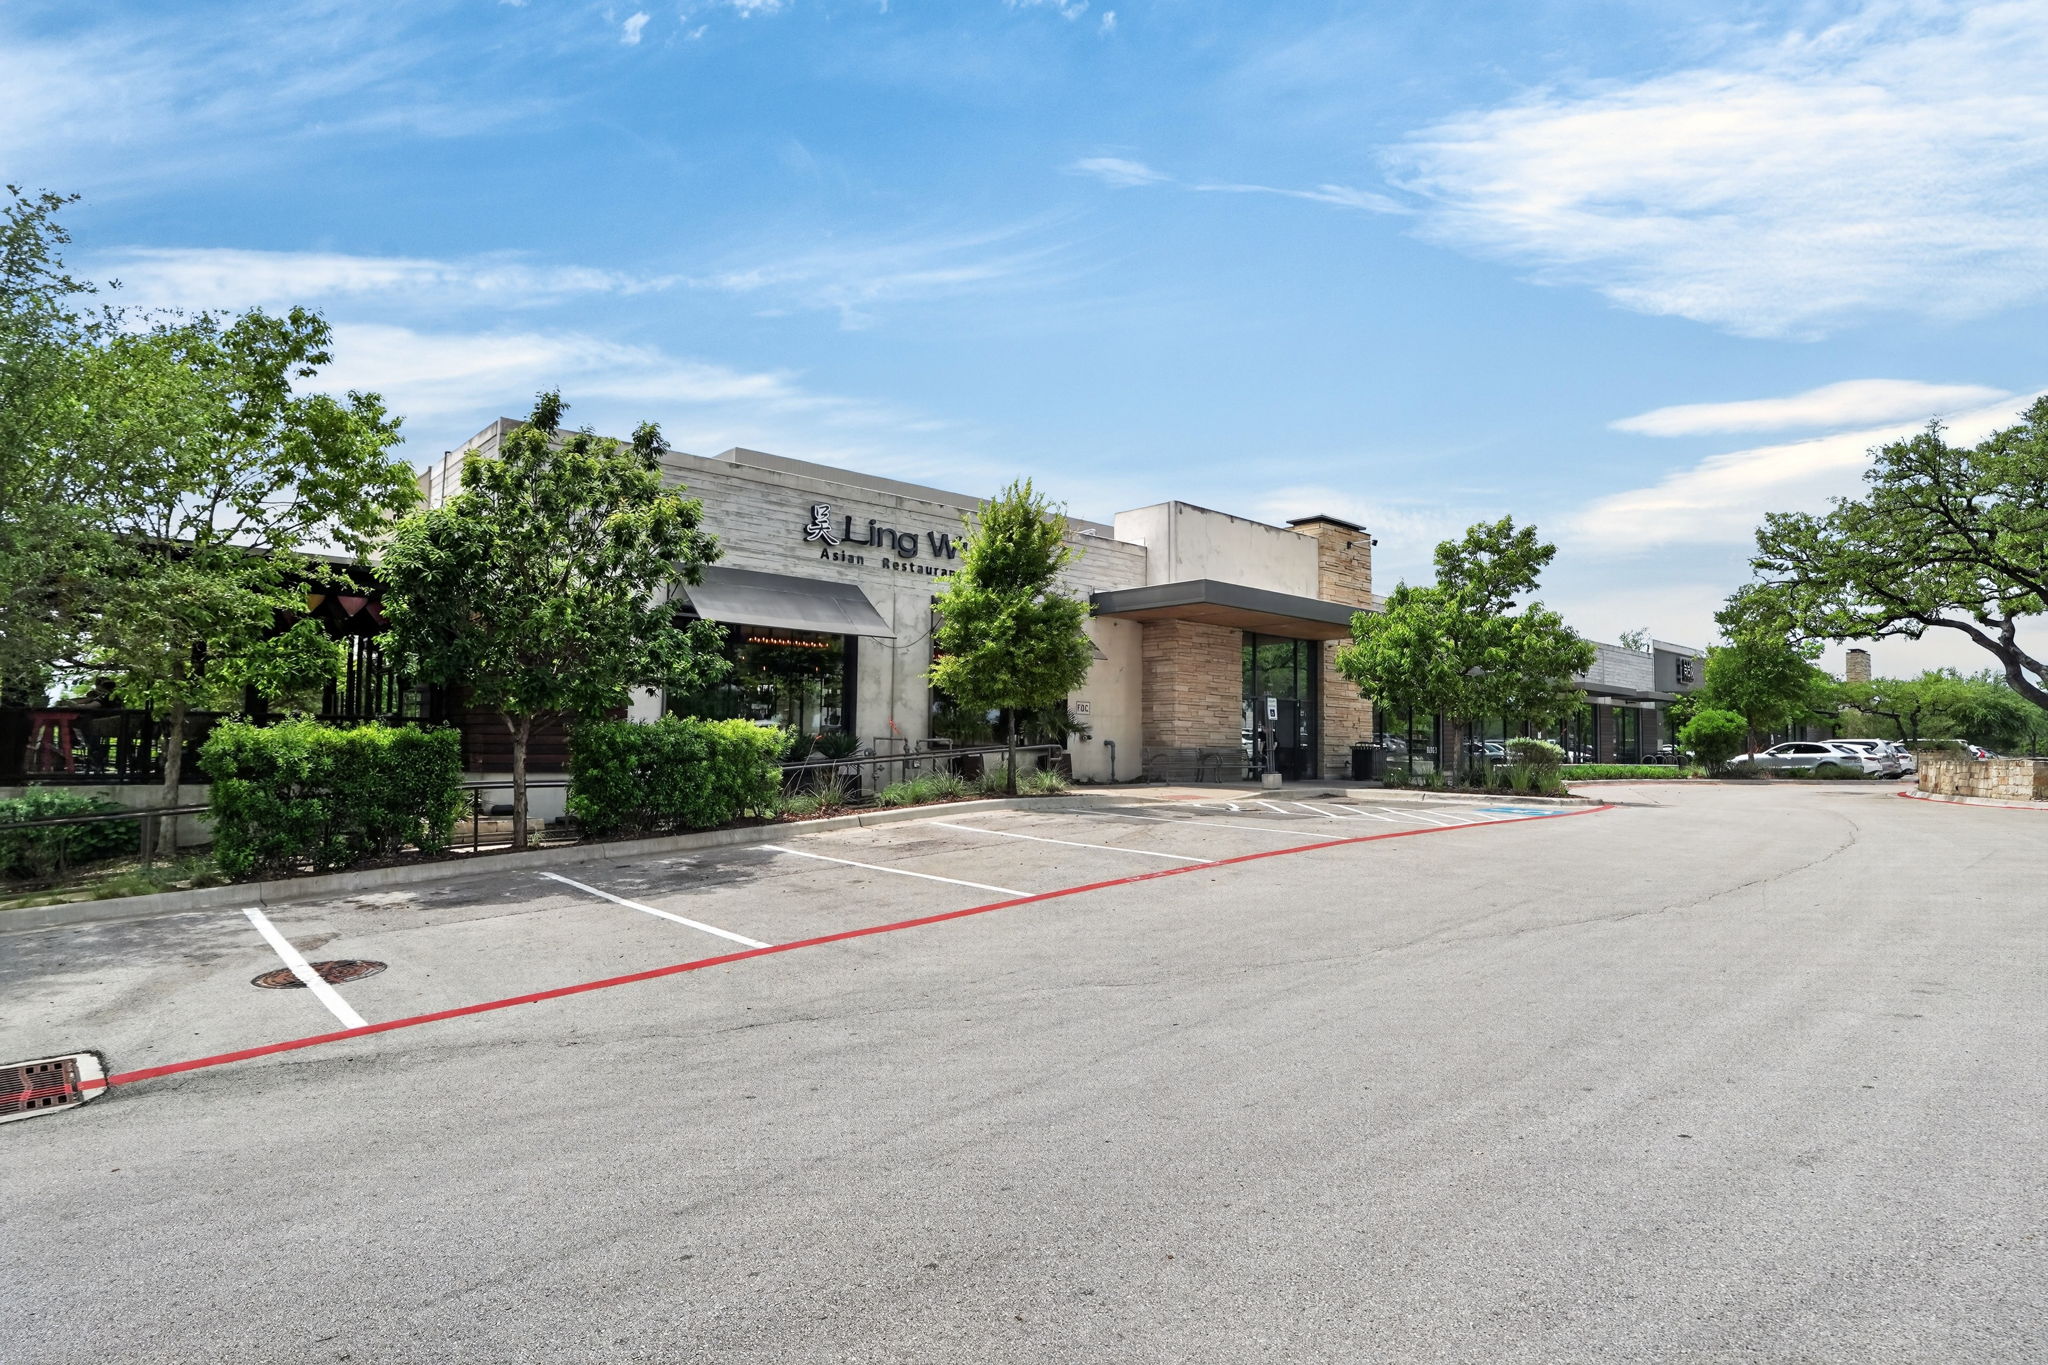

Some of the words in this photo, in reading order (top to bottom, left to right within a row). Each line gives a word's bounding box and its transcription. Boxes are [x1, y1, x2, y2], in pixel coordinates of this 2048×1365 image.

[841, 515, 919, 558] Ling
[820, 548, 864, 565] Asian
[882, 558, 956, 577] Restauran
